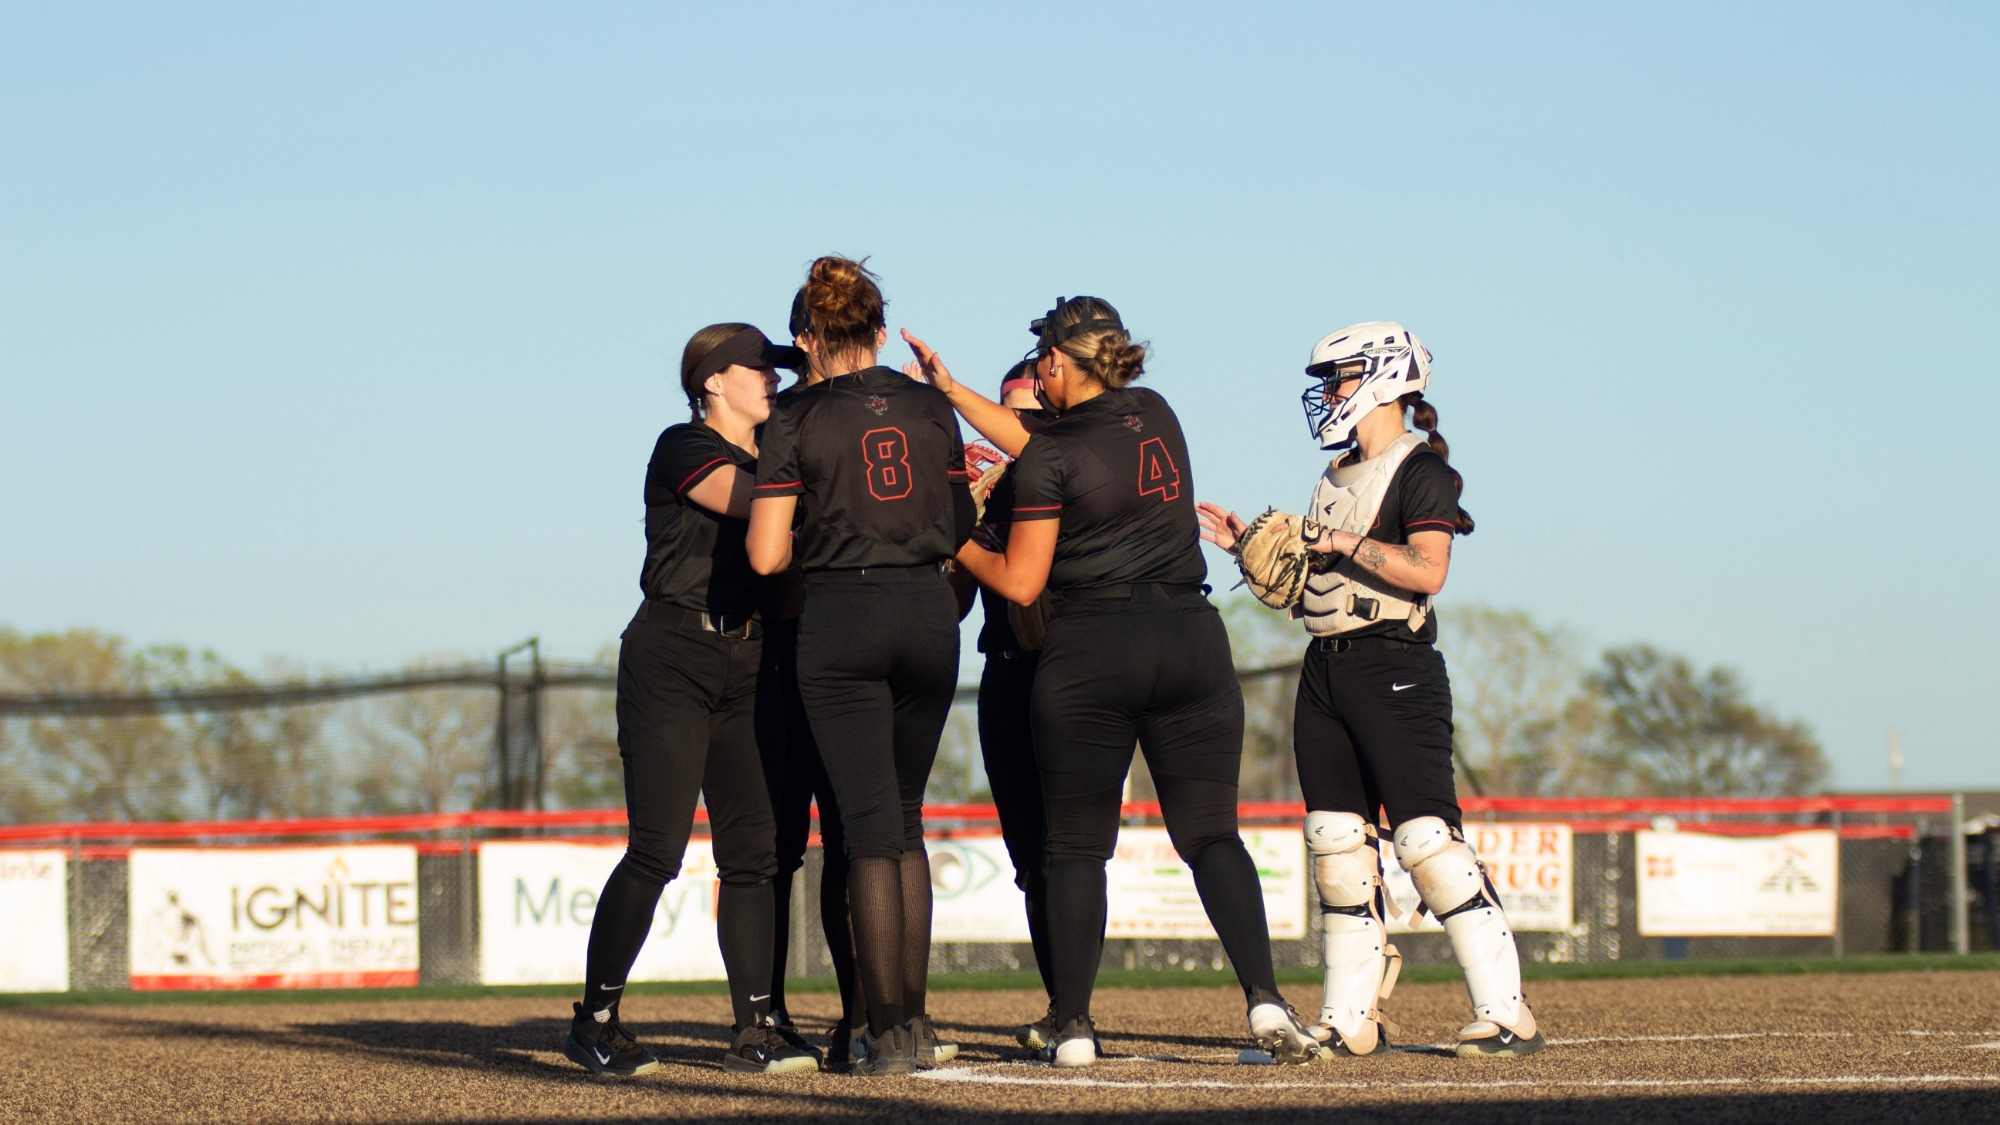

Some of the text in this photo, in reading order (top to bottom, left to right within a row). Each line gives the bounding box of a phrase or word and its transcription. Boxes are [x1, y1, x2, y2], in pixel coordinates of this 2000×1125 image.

[862, 426, 913, 502] 8
[1137, 436, 1181, 503] 4
[231, 882, 417, 932] IGNITE
[514, 876, 686, 938] Mey
[1485, 862, 1561, 891] RUG
